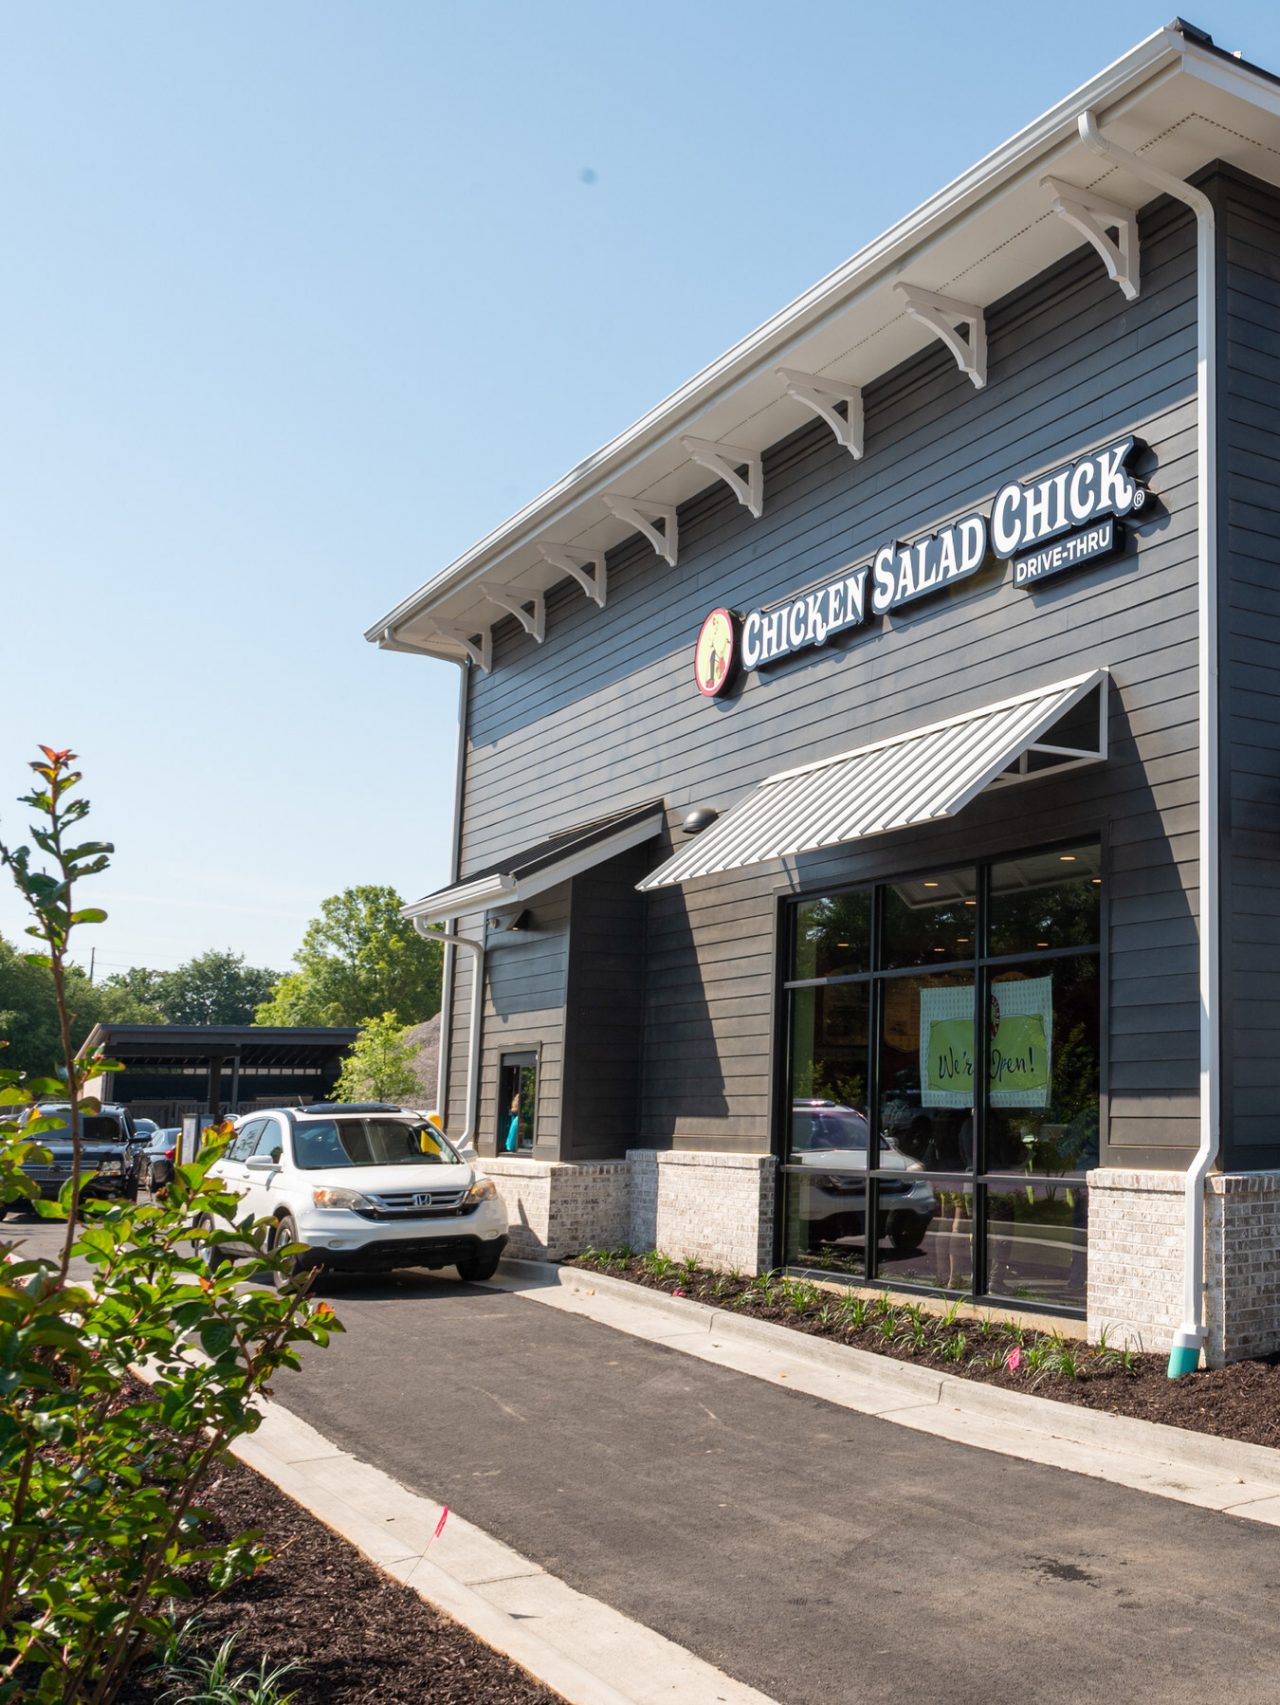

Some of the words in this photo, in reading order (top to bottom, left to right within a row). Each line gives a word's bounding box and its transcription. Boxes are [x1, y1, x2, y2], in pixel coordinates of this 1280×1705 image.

[1016, 526, 1111, 583] DRIVE-THRU
[742, 572, 866, 669] CHICKEN
[873, 517, 985, 610] SALAD
[939, 1047, 974, 1079] We'r
